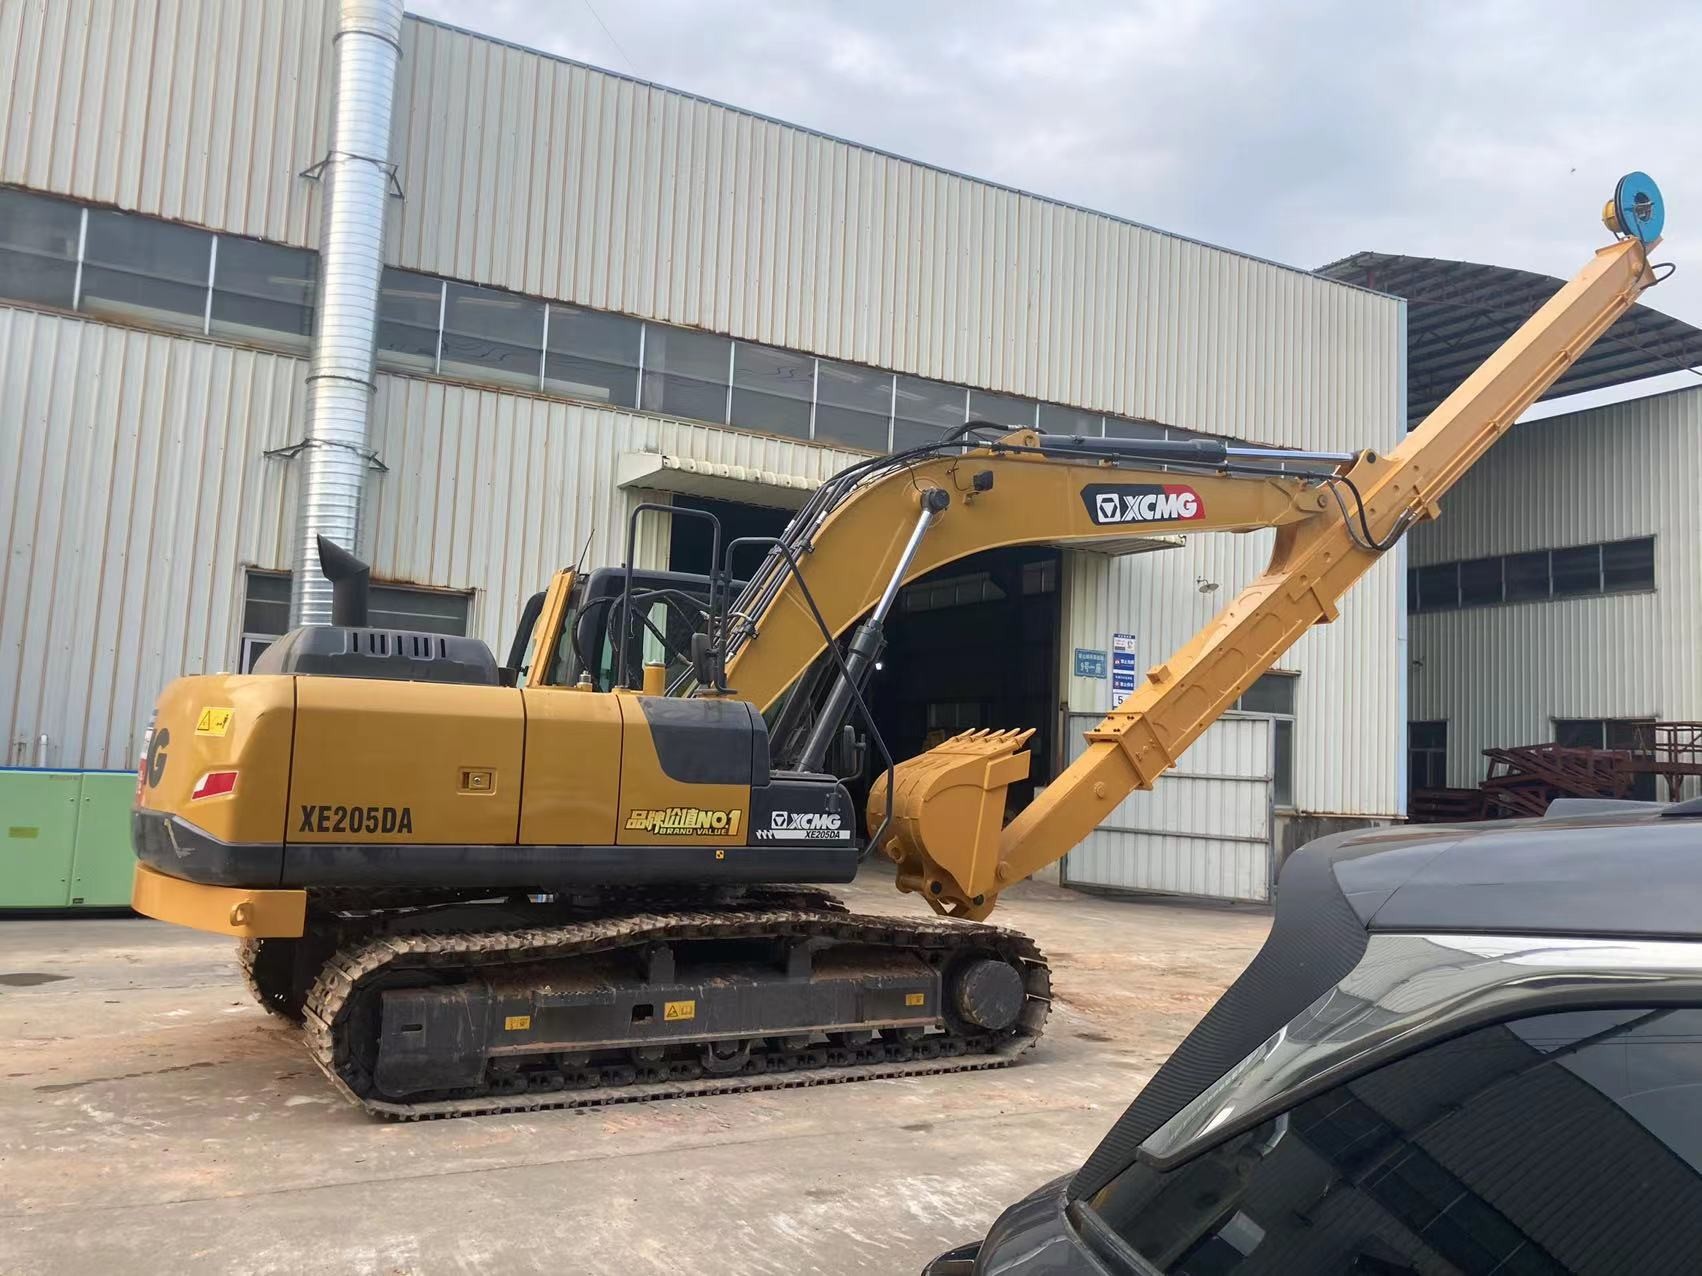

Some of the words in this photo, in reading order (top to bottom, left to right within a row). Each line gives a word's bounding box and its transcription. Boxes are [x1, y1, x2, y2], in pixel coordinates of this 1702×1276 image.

[1121, 492, 1198, 522] XCMG
[299, 805, 413, 834] XE205DA
[787, 813, 841, 830] XCMG
[659, 827, 693, 835] BRAND
[697, 827, 728, 835] VALUE
[804, 830, 840, 839] XE205DA
